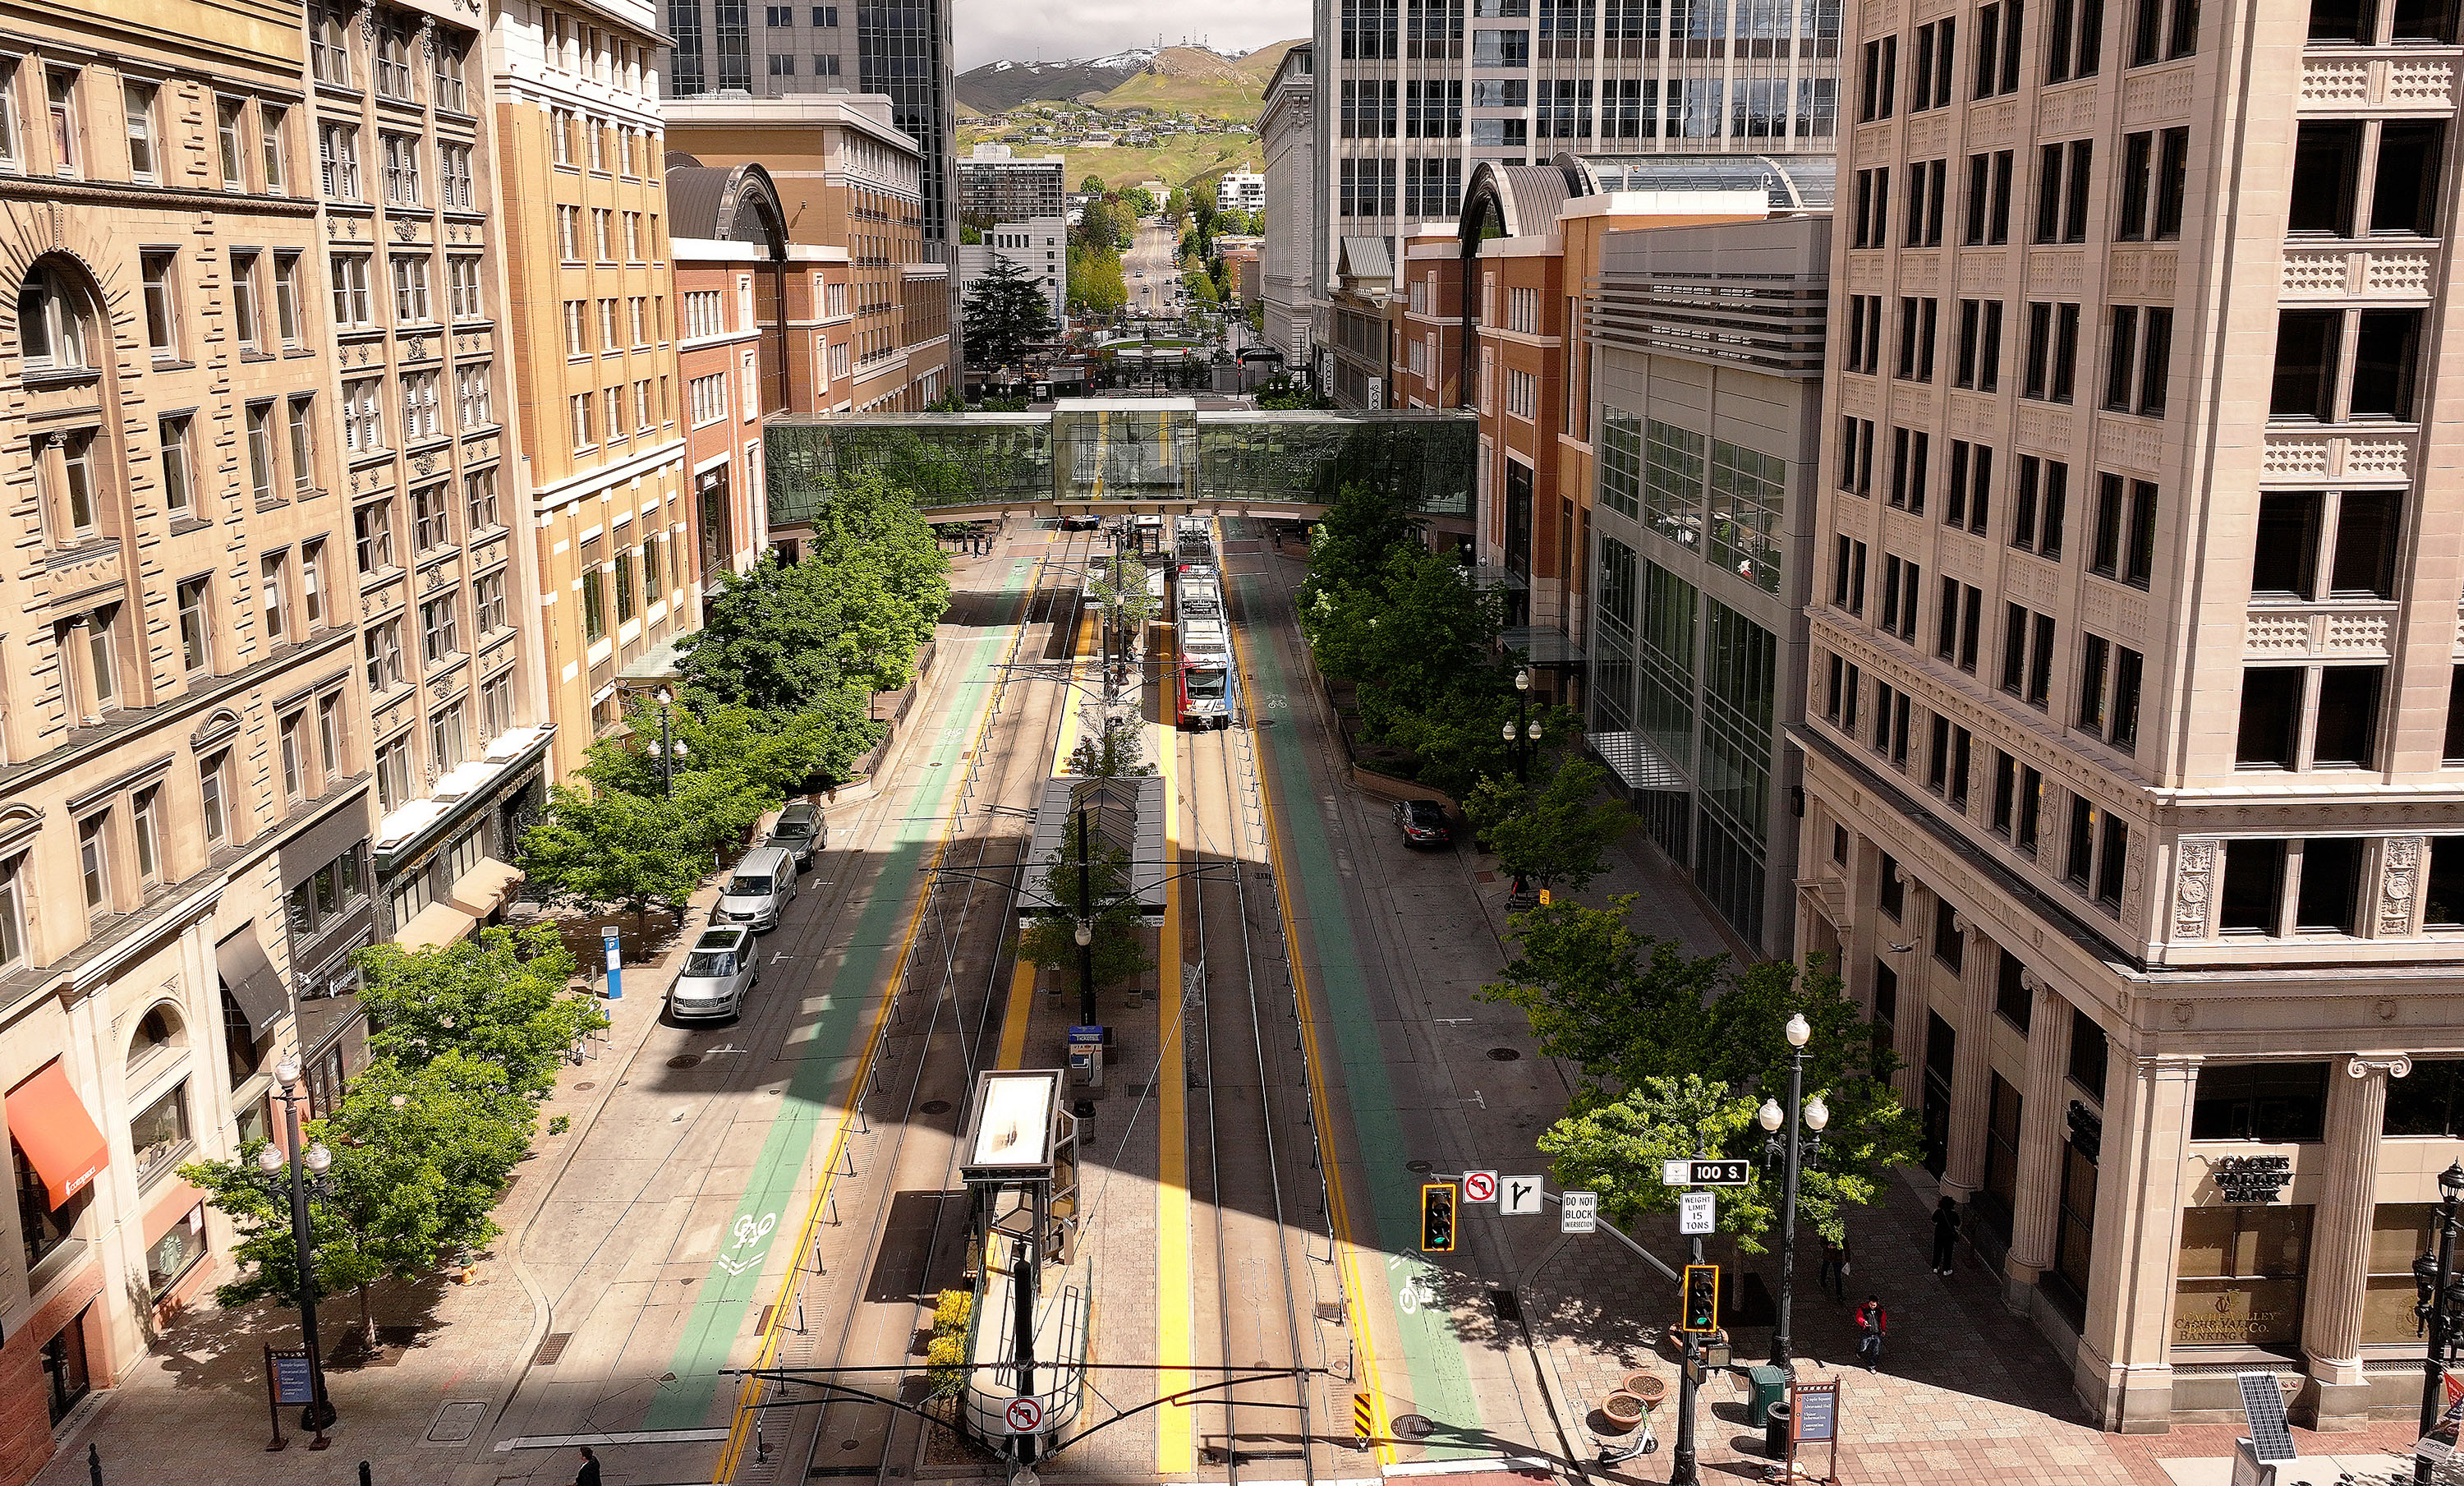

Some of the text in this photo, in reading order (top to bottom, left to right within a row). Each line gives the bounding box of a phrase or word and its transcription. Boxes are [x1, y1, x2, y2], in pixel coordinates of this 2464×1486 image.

[1369, 384, 1381, 411] acy's
[1868, 800, 2020, 931] DESERET BANK BUILDING
[2219, 1155, 2290, 1170] CACHE
[1697, 1166, 1722, 1180] 100
[2212, 1171, 2296, 1186] VALLEY
[1565, 1196, 1594, 1206] DO NOT
[2222, 1187, 2281, 1203] BANK
[1565, 1209, 1593, 1219] BLOCK
[1693, 1212, 1703, 1220] 15
[1686, 1221, 1709, 1230] TONS
